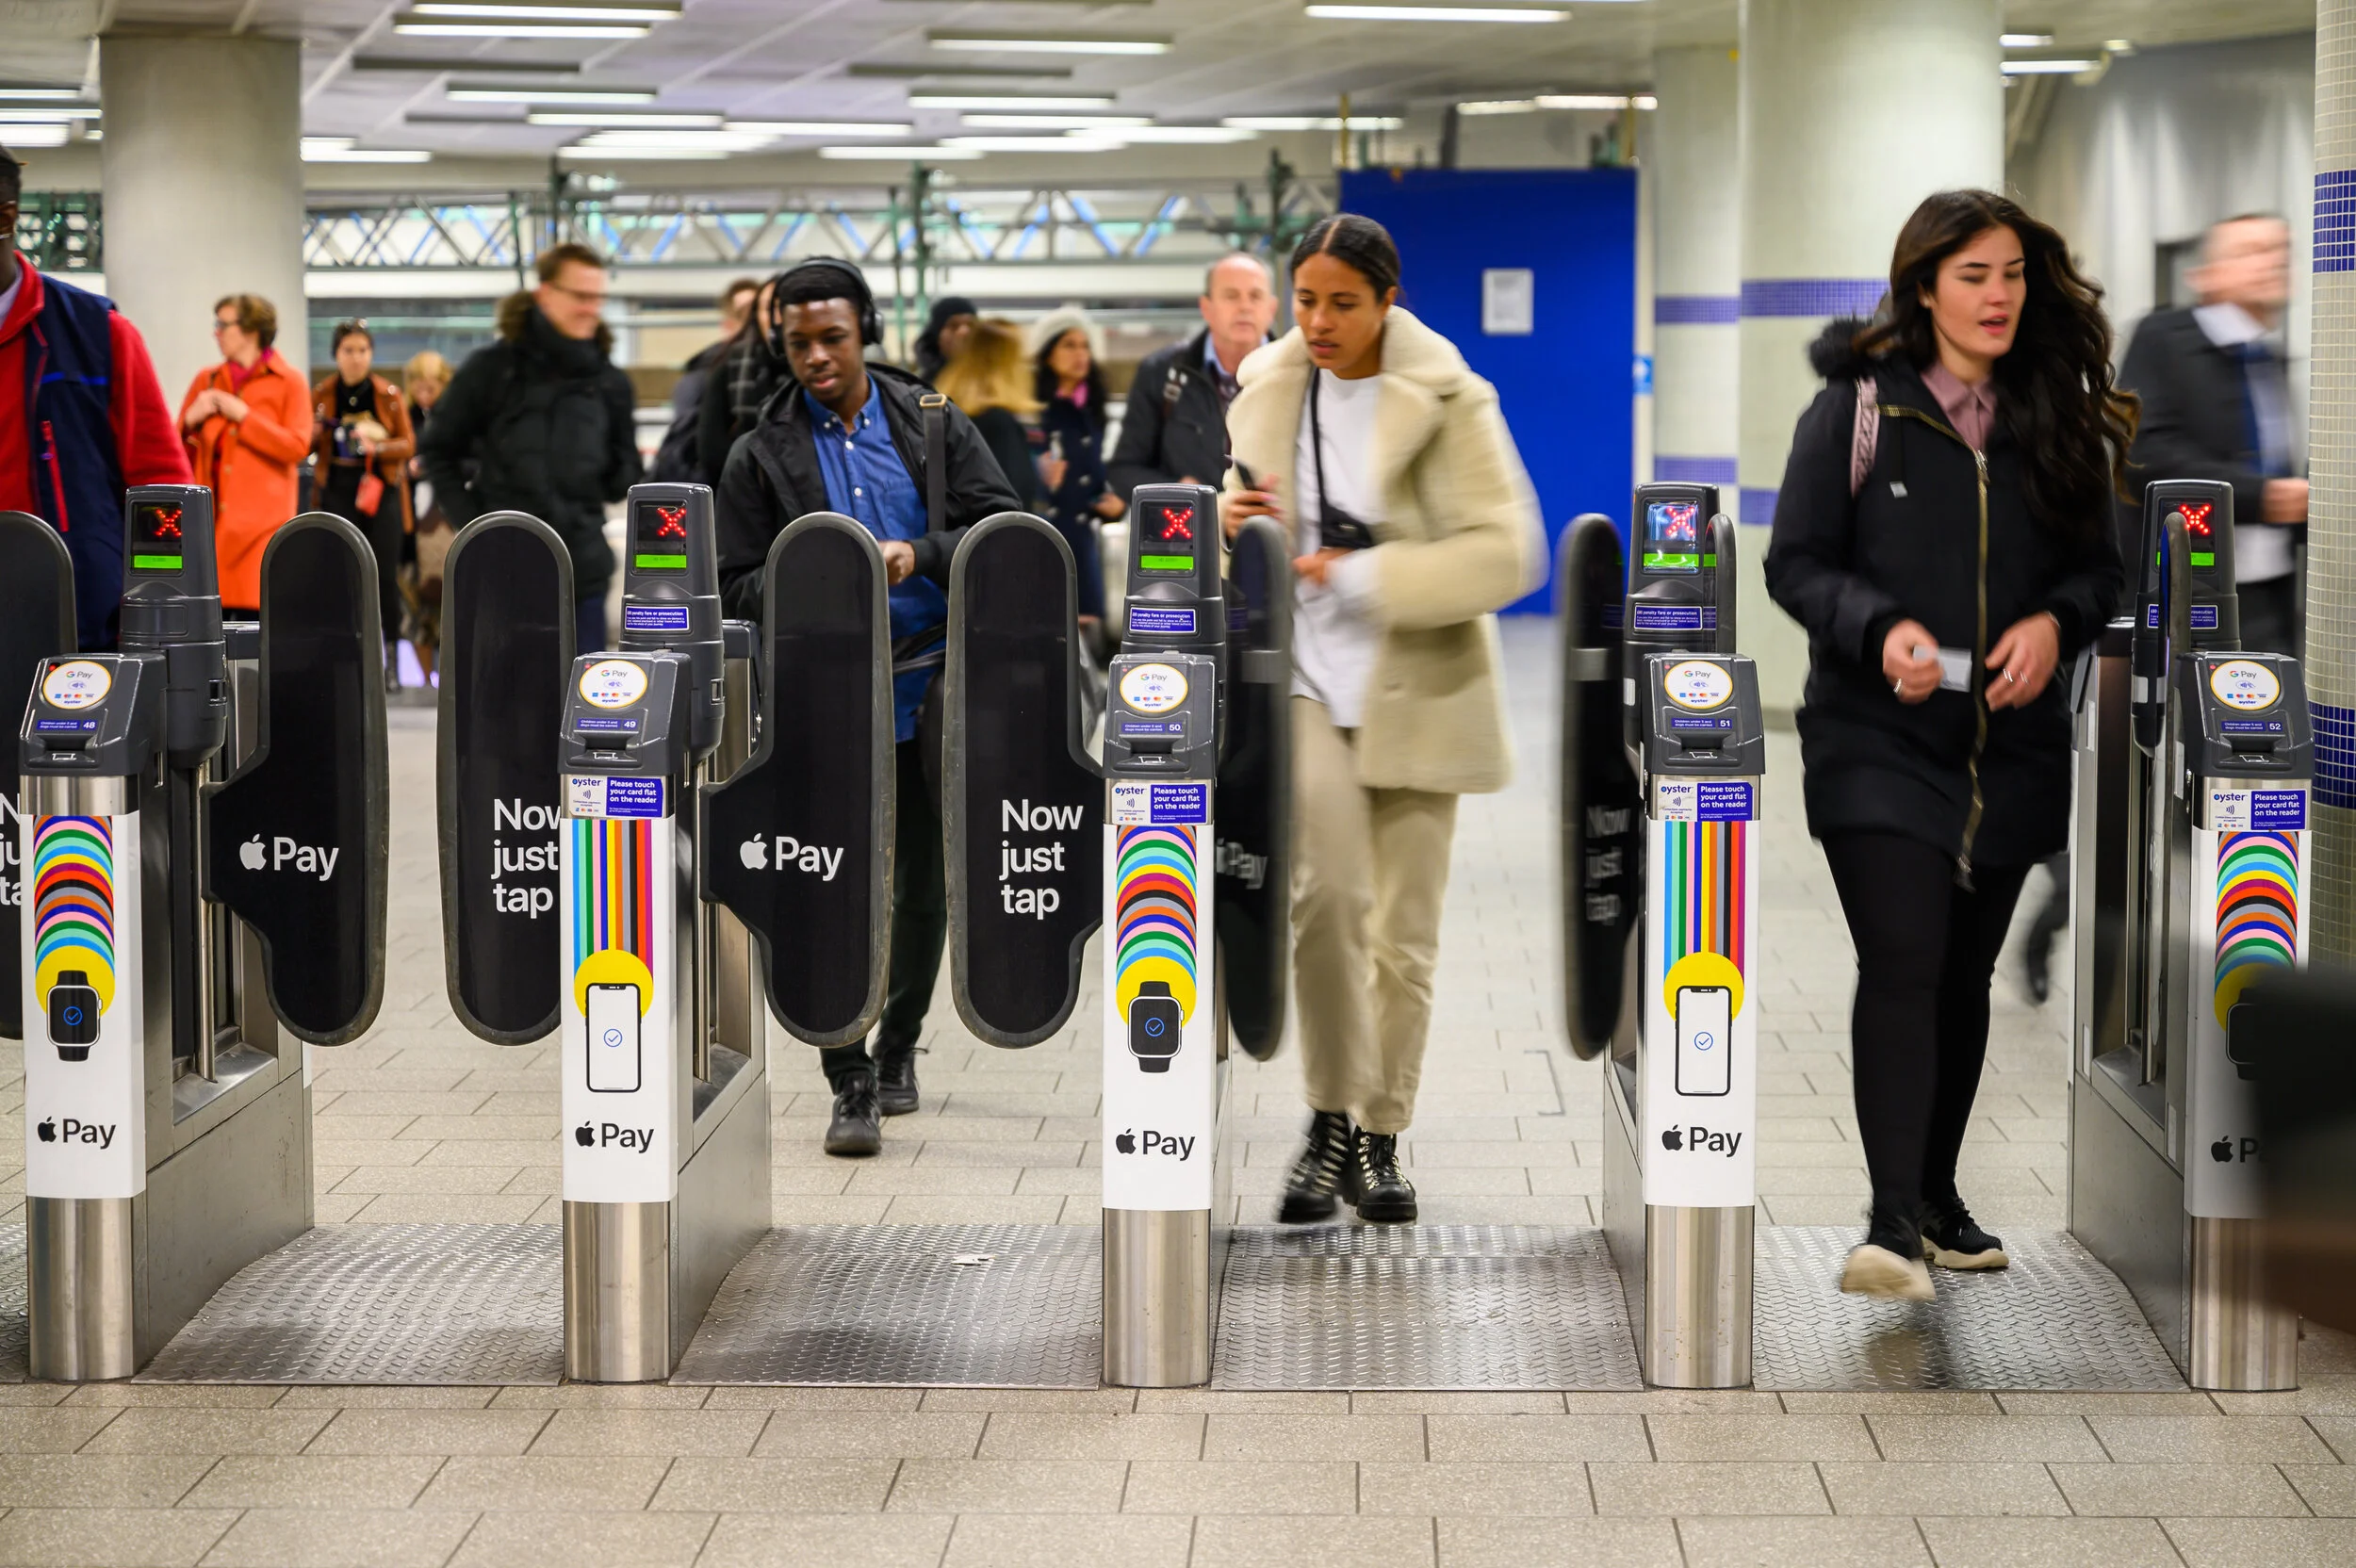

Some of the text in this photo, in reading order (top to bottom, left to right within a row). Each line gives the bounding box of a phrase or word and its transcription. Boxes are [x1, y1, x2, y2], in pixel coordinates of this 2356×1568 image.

[83, 721, 96, 729] 48
[572, 778, 601, 788] oyster
[610, 779, 633, 788] Please
[1115, 786, 1145, 796] oyster
[1661, 785, 1692, 795] oyster
[2214, 792, 2246, 803] oyster
[1002, 798, 1084, 832] Now
[274, 836, 338, 882] Pay
[490, 839, 559, 880] just
[777, 836, 843, 882] Pay
[998, 840, 1066, 881] just
[492, 883, 554, 920] tap
[1001, 884, 1060, 921] tap
[62, 1119, 117, 1150] Pay
[601, 1122, 655, 1154] Pay
[1142, 1130, 1196, 1162] Pay
[1689, 1126, 1742, 1158] Pay
